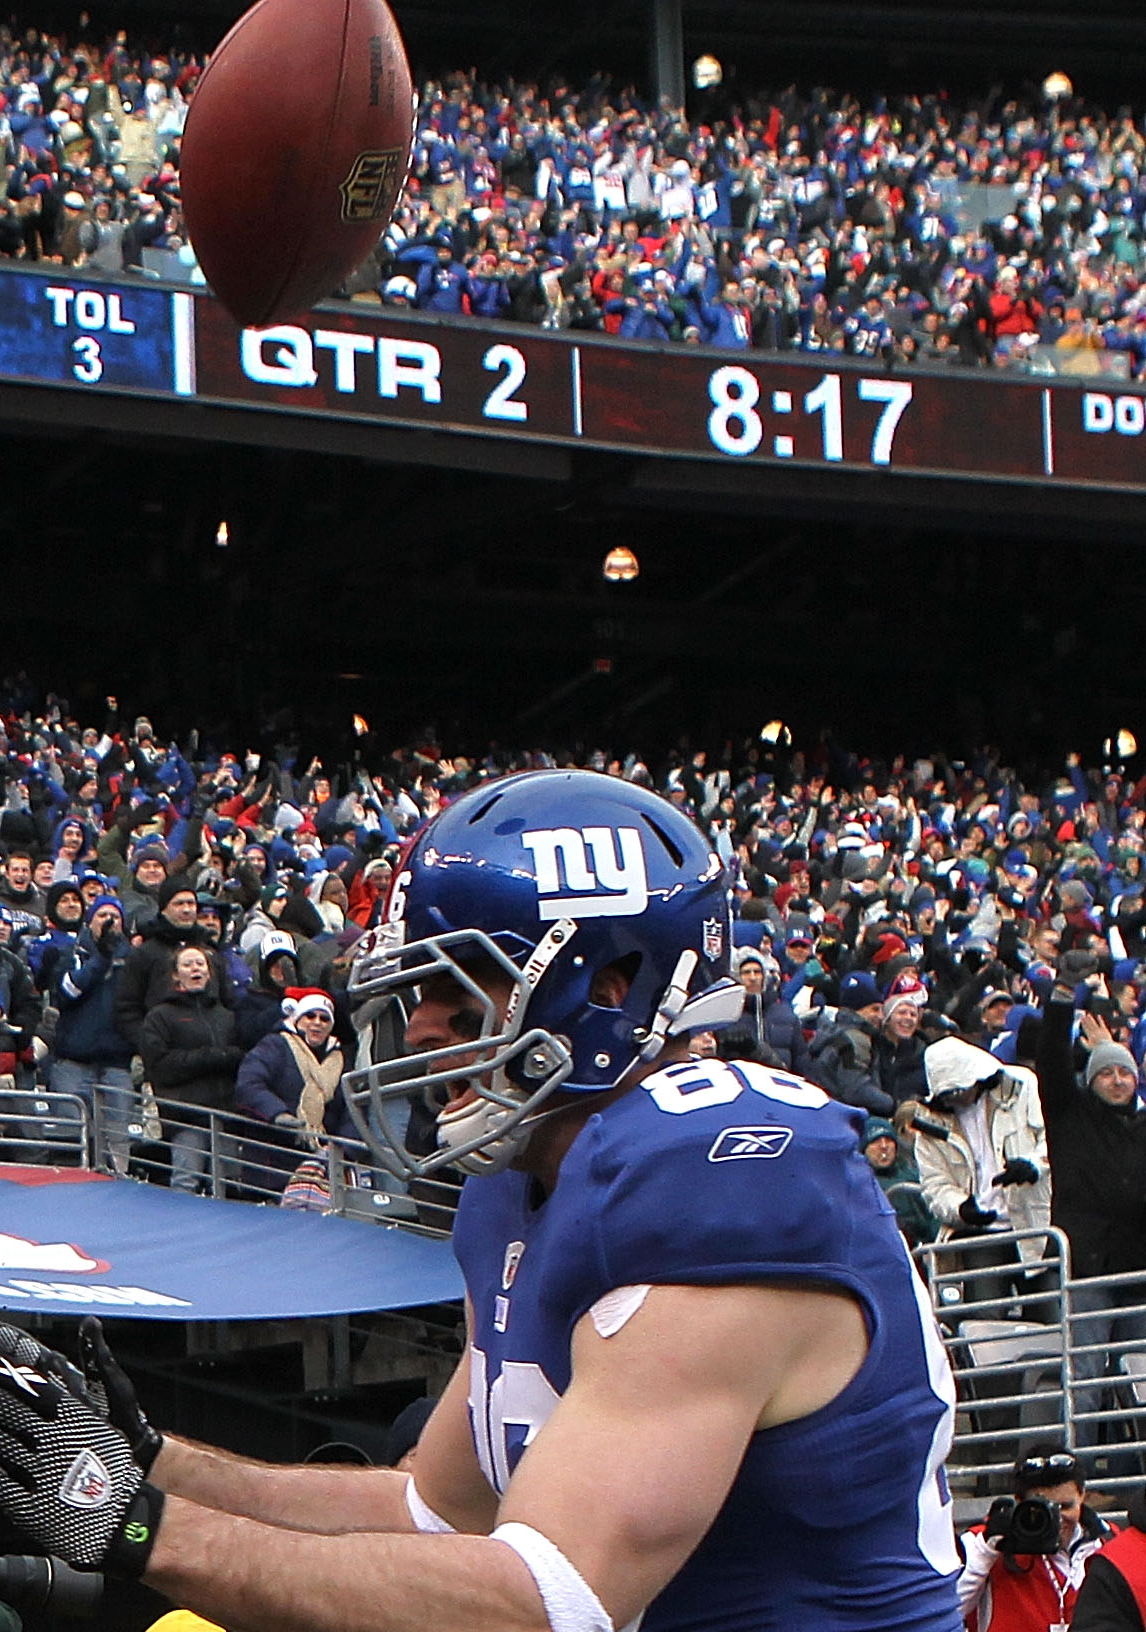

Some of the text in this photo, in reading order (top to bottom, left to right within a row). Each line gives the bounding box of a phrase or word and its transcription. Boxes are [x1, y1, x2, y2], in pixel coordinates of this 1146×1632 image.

[45, 286, 136, 333] TOL
[72, 335, 104, 383] 3
[240, 325, 528, 420] QTR 2
[708, 365, 914, 465] 8:17
[522, 826, 649, 921] ny
[639, 1057, 832, 1116] 86
